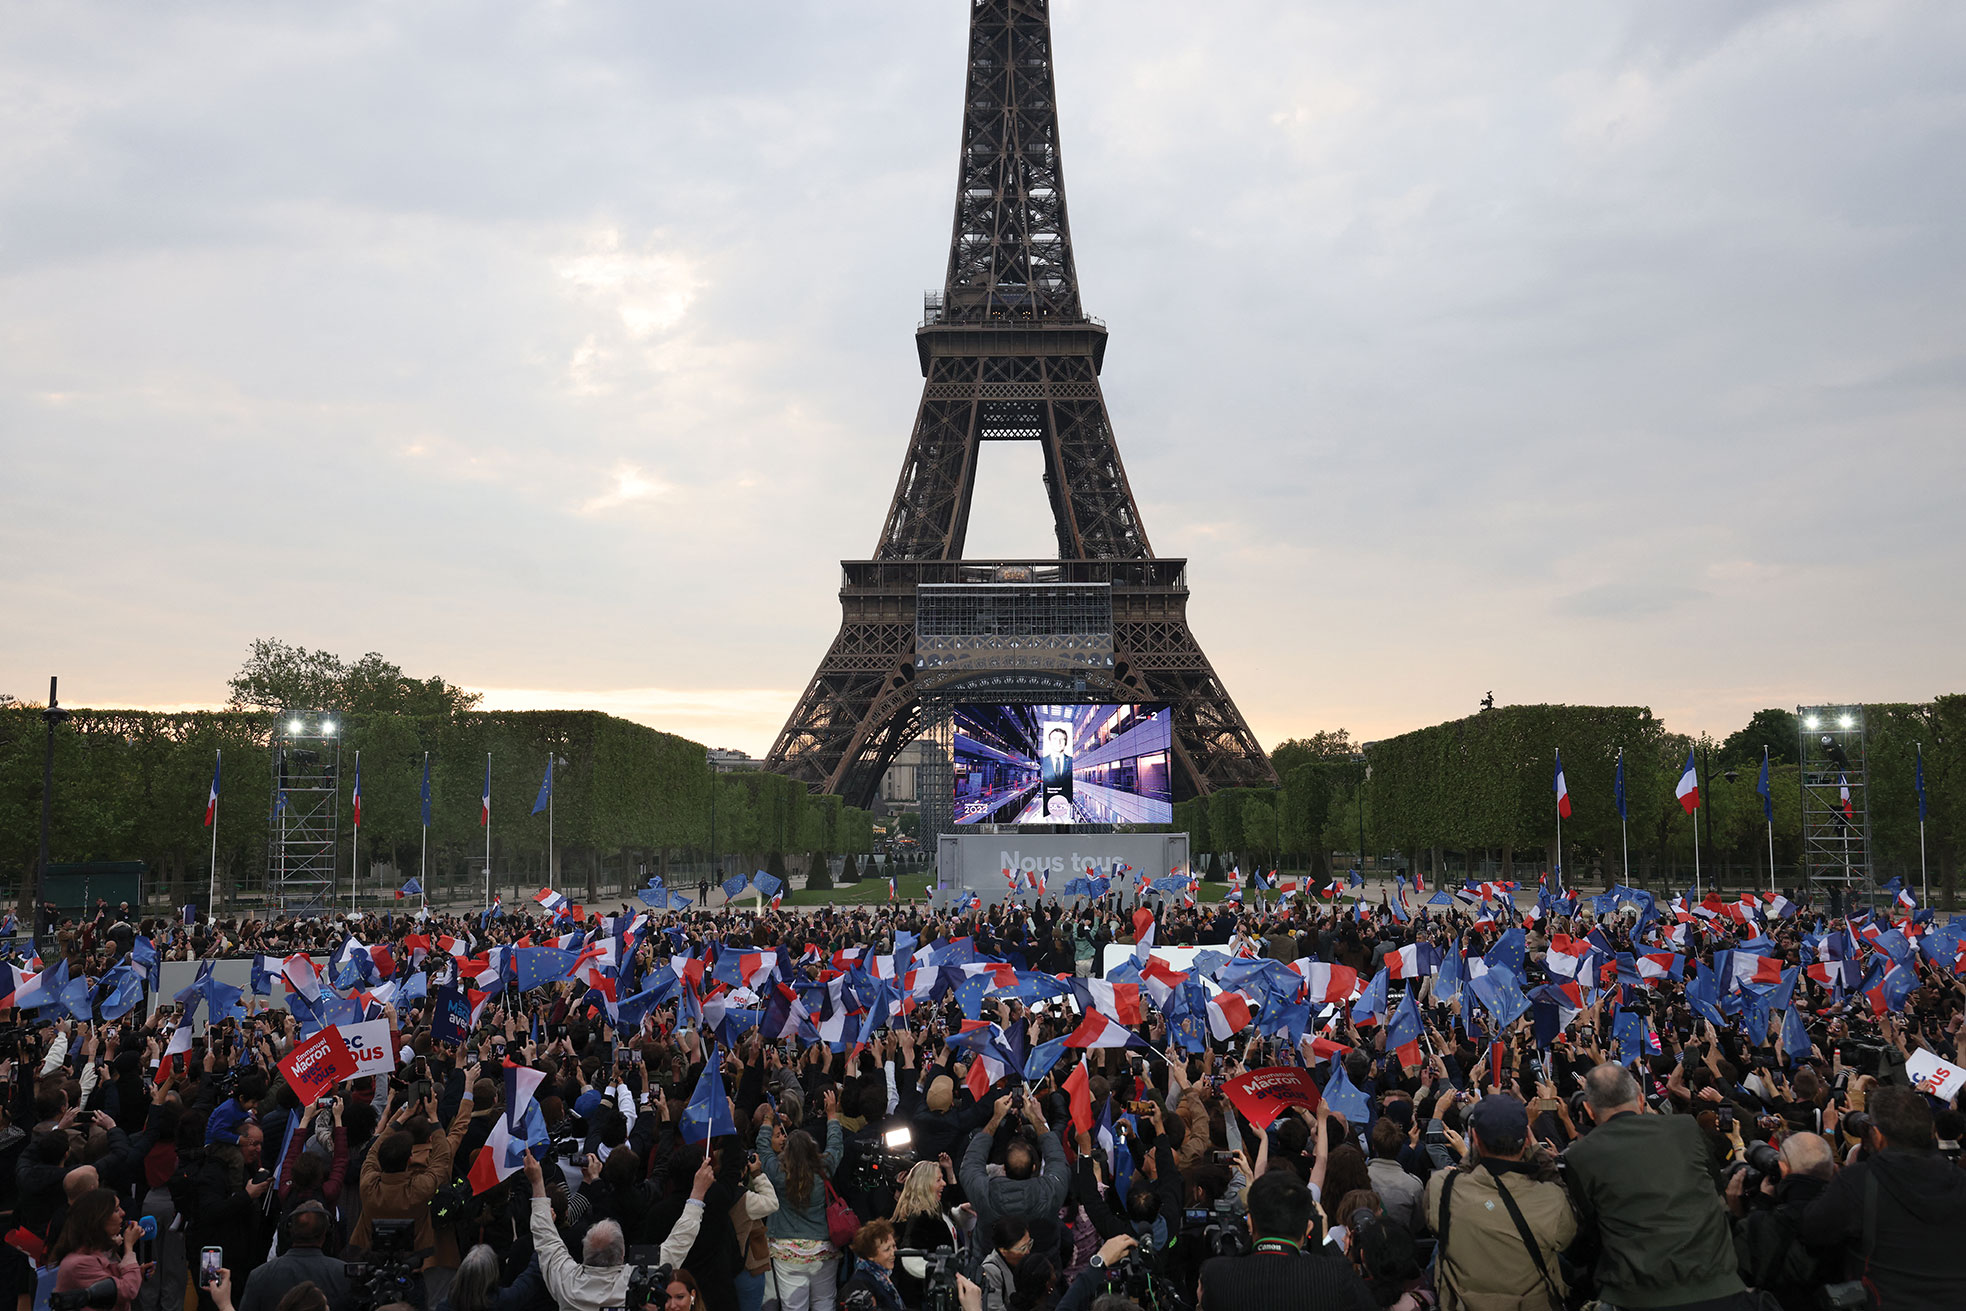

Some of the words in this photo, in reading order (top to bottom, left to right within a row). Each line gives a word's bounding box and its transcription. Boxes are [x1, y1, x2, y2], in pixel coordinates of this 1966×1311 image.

[964, 806, 988, 814] 2022
[1000, 851, 1064, 872] Nous
[296, 1037, 327, 1062] Emmanuel
[344, 1035, 364, 1049] ec
[291, 1044, 331, 1078] Macron
[350, 1046, 384, 1061] ous
[301, 1062, 322, 1083] avec
[311, 1064, 336, 1085] vous
[1253, 1072, 1295, 1081] Emmanuel
[1242, 1076, 1301, 1095] Macron
[1256, 1085, 1290, 1099] avec
[1273, 1089, 1309, 1100] vous
[1257, 1243, 1282, 1251] Canon
